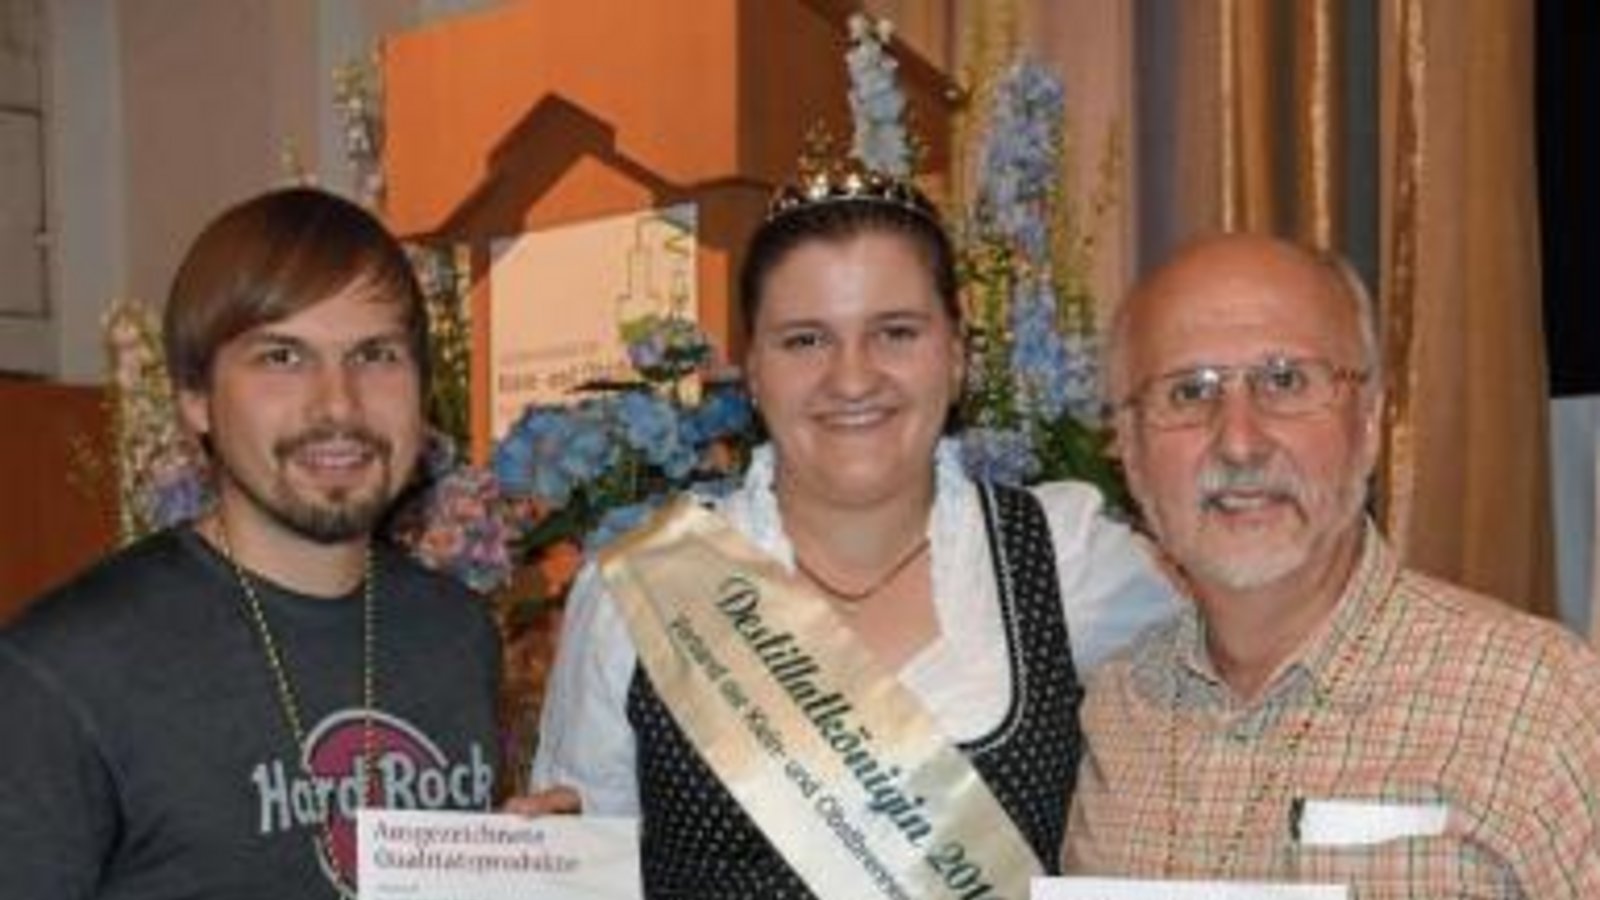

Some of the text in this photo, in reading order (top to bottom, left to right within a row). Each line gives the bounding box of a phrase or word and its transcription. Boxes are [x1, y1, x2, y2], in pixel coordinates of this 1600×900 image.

[714, 576, 1005, 900] Destillatkönigin 201
[784, 761, 821, 799] und
[251, 743, 492, 834] Hard Rock
